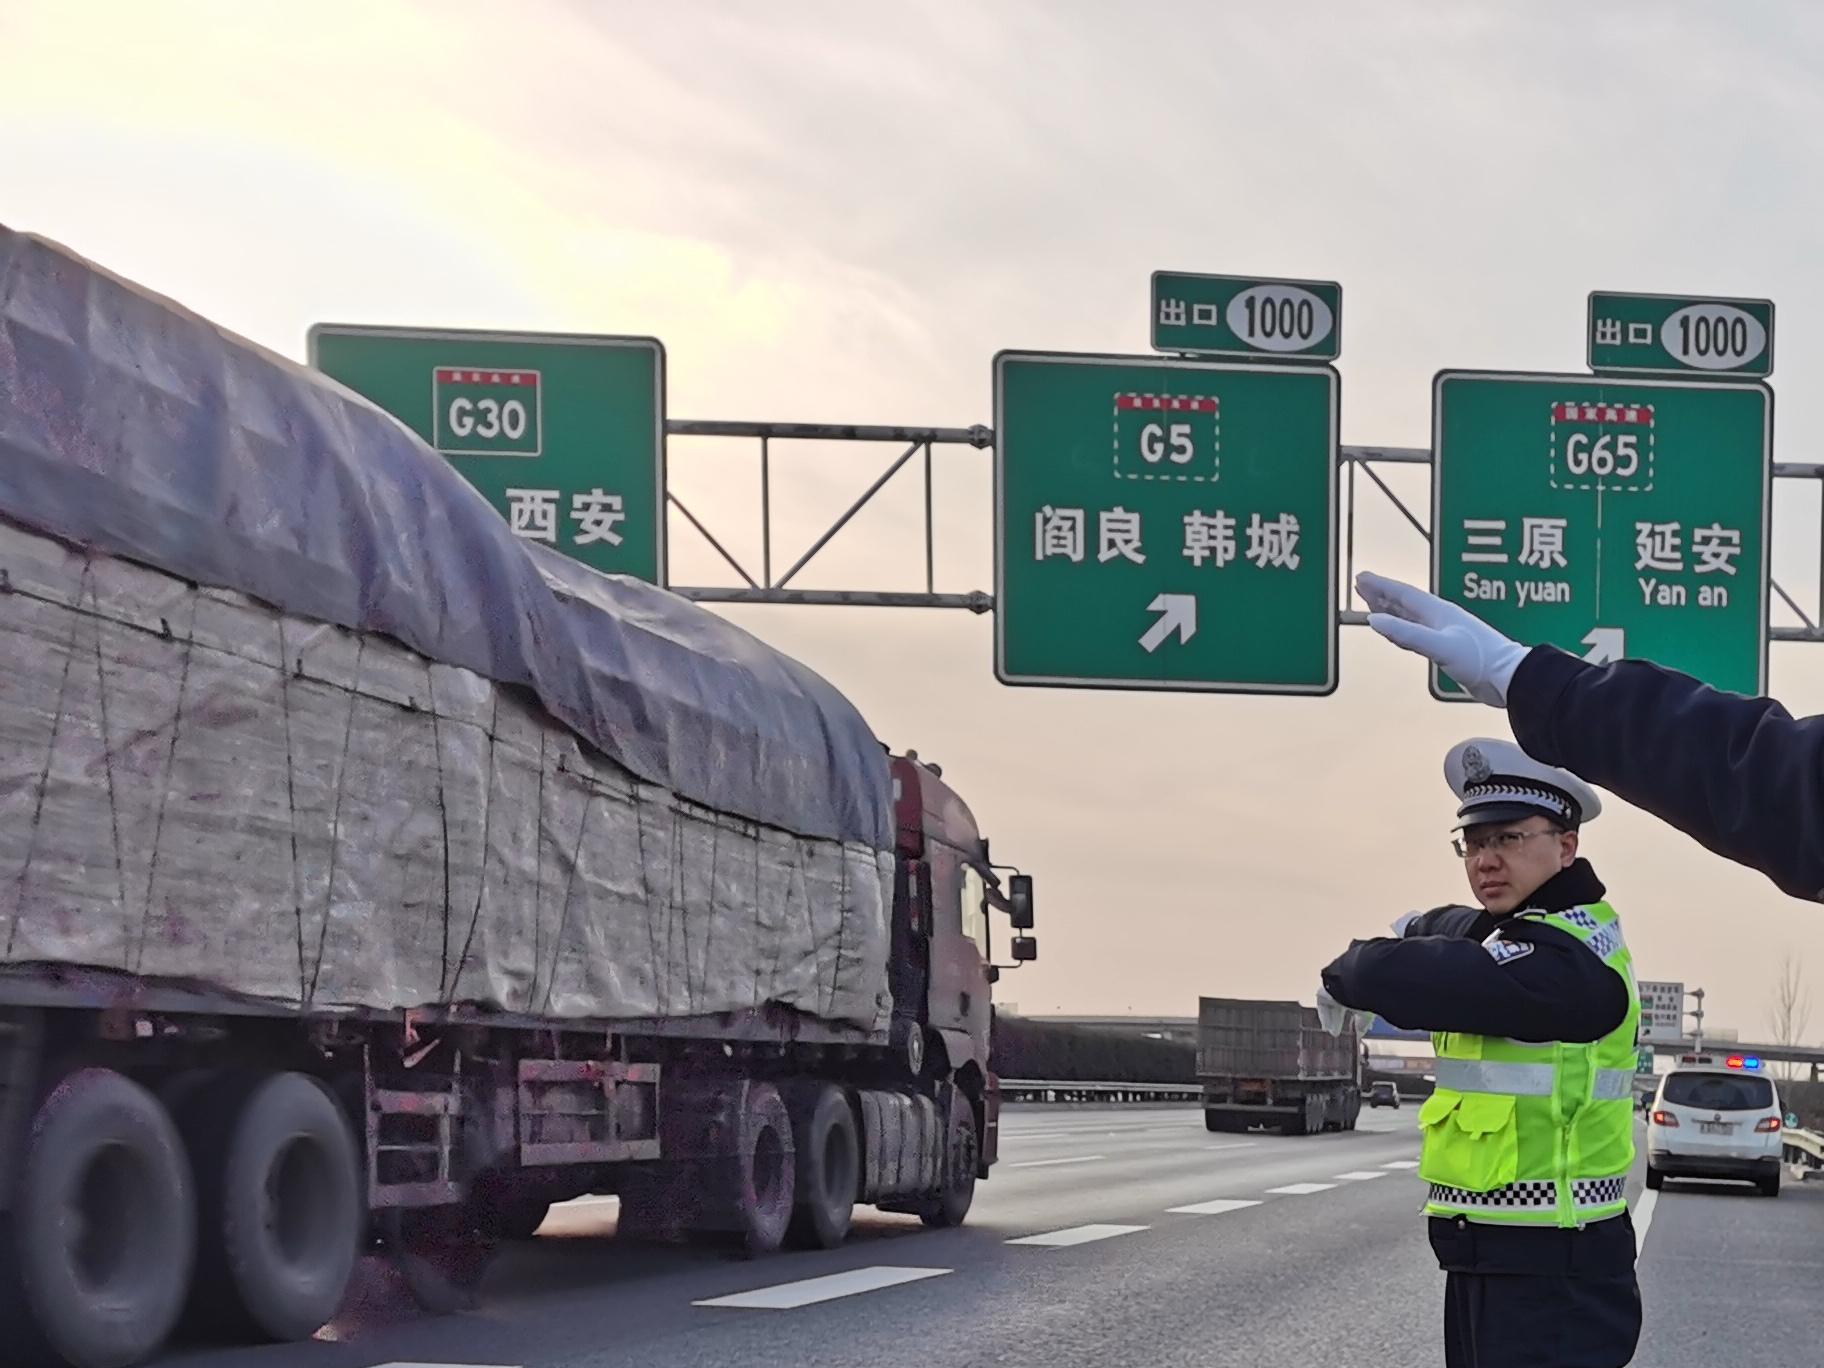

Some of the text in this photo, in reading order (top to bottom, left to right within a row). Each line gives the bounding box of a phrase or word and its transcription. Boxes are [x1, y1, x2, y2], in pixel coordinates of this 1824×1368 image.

[1160, 294, 1315, 341] 出口 1000
[1596, 315, 1748, 358] 出口 1000
[449, 397, 526, 440] G30
[1140, 423, 1194, 464] G5
[1566, 432, 1639, 477] G65
[505, 487, 626, 546] 西安
[1035, 504, 1301, 571] 阎良 韩城
[1461, 516, 1742, 576] 三原 延安
[1463, 572, 1728, 608] San yuan Yan an
